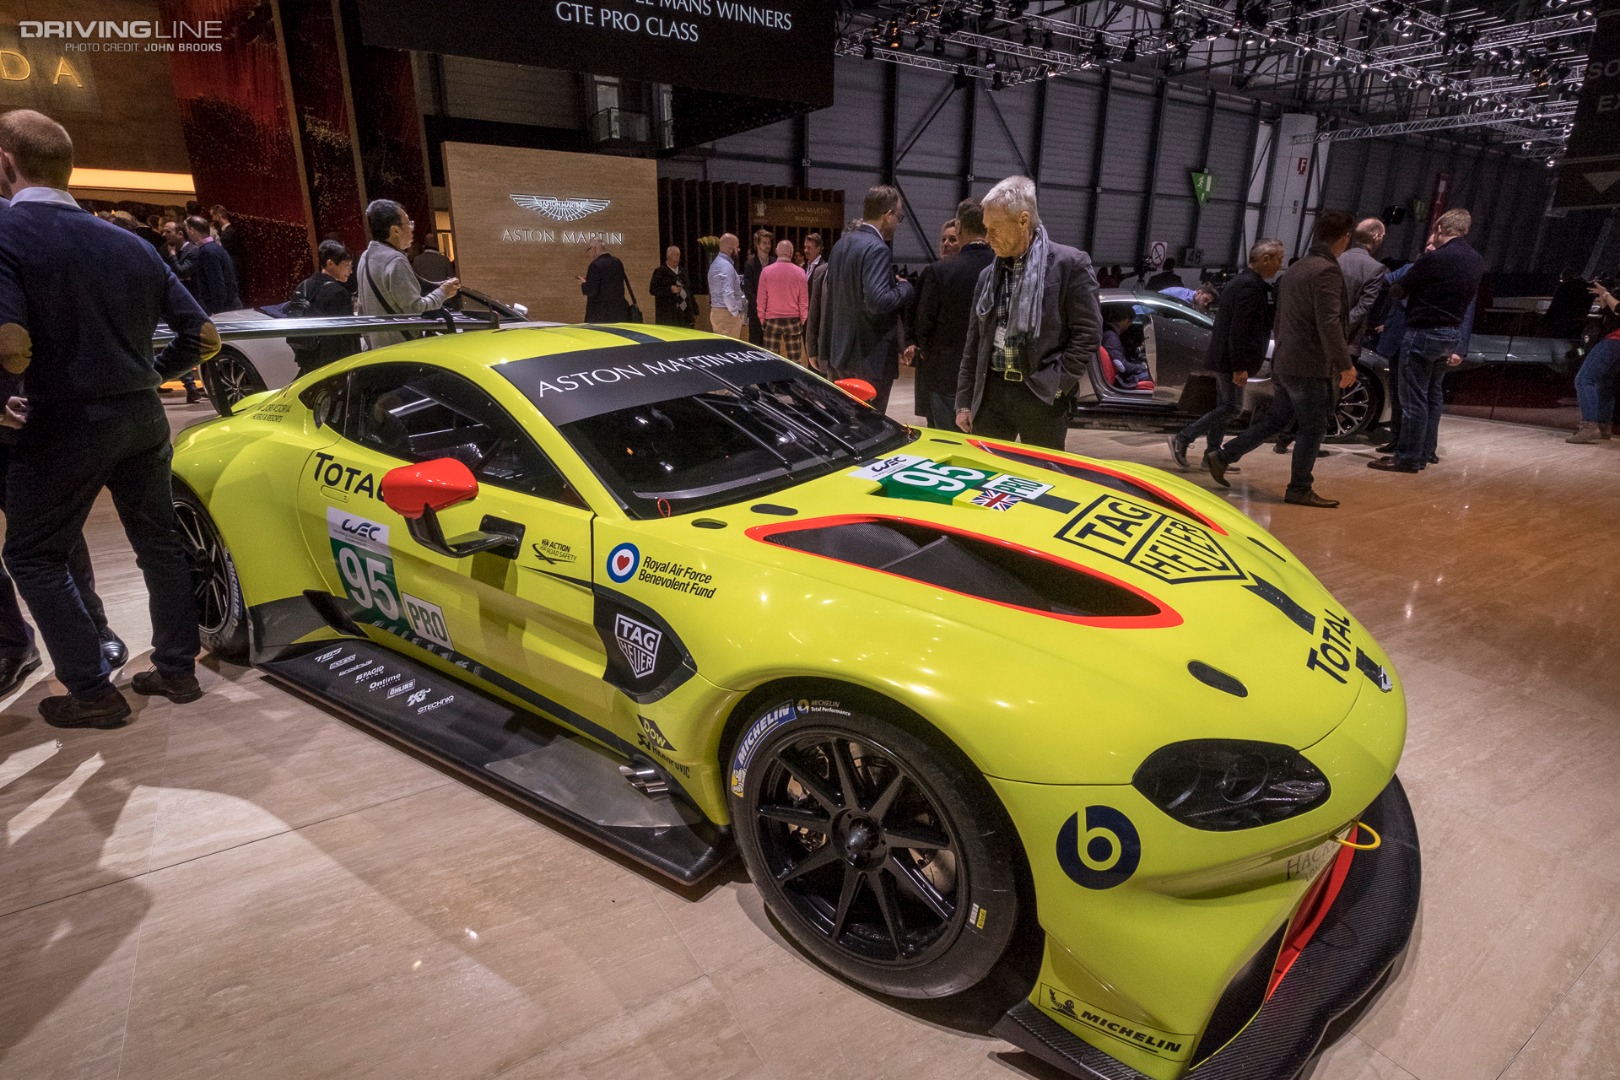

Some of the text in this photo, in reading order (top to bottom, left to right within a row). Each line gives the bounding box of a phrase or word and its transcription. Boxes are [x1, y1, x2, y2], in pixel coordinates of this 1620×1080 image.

[555, 1, 698, 42] GTE PRO CLASS
[716, 0, 792, 30] WINNERS
[502, 228, 623, 245] ASTON MARTIN
[539, 364, 644, 398] ASTON
[871, 456, 907, 472] WEC
[892, 462, 986, 492] 95
[993, 479, 1043, 497] PRO
[341, 519, 381, 541] WEC
[1075, 502, 1153, 547] TAG
[546, 547, 560, 558] ROAD
[558, 550, 578, 562] SAFETY
[549, 541, 571, 553] ACTION
[1140, 521, 1231, 575] HEUER
[338, 547, 399, 621] 95
[638, 570, 717, 600] Benevolent Fund
[642, 556, 712, 584] Royal Air Force
[406, 601, 449, 643] PRO
[620, 619, 657, 652] TAG
[619, 641, 654, 674] HEUER
[1306, 608, 1352, 685] TOTAL
[361, 665, 385, 678] PAGID
[369, 673, 401, 689] Ontime
[811, 699, 840, 707] MICHELIN
[821, 706, 852, 717] Performance
[643, 719, 667, 748] DOW
[737, 703, 791, 766] MICHELIN
[1080, 1010, 1182, 1053] MICHELIN
